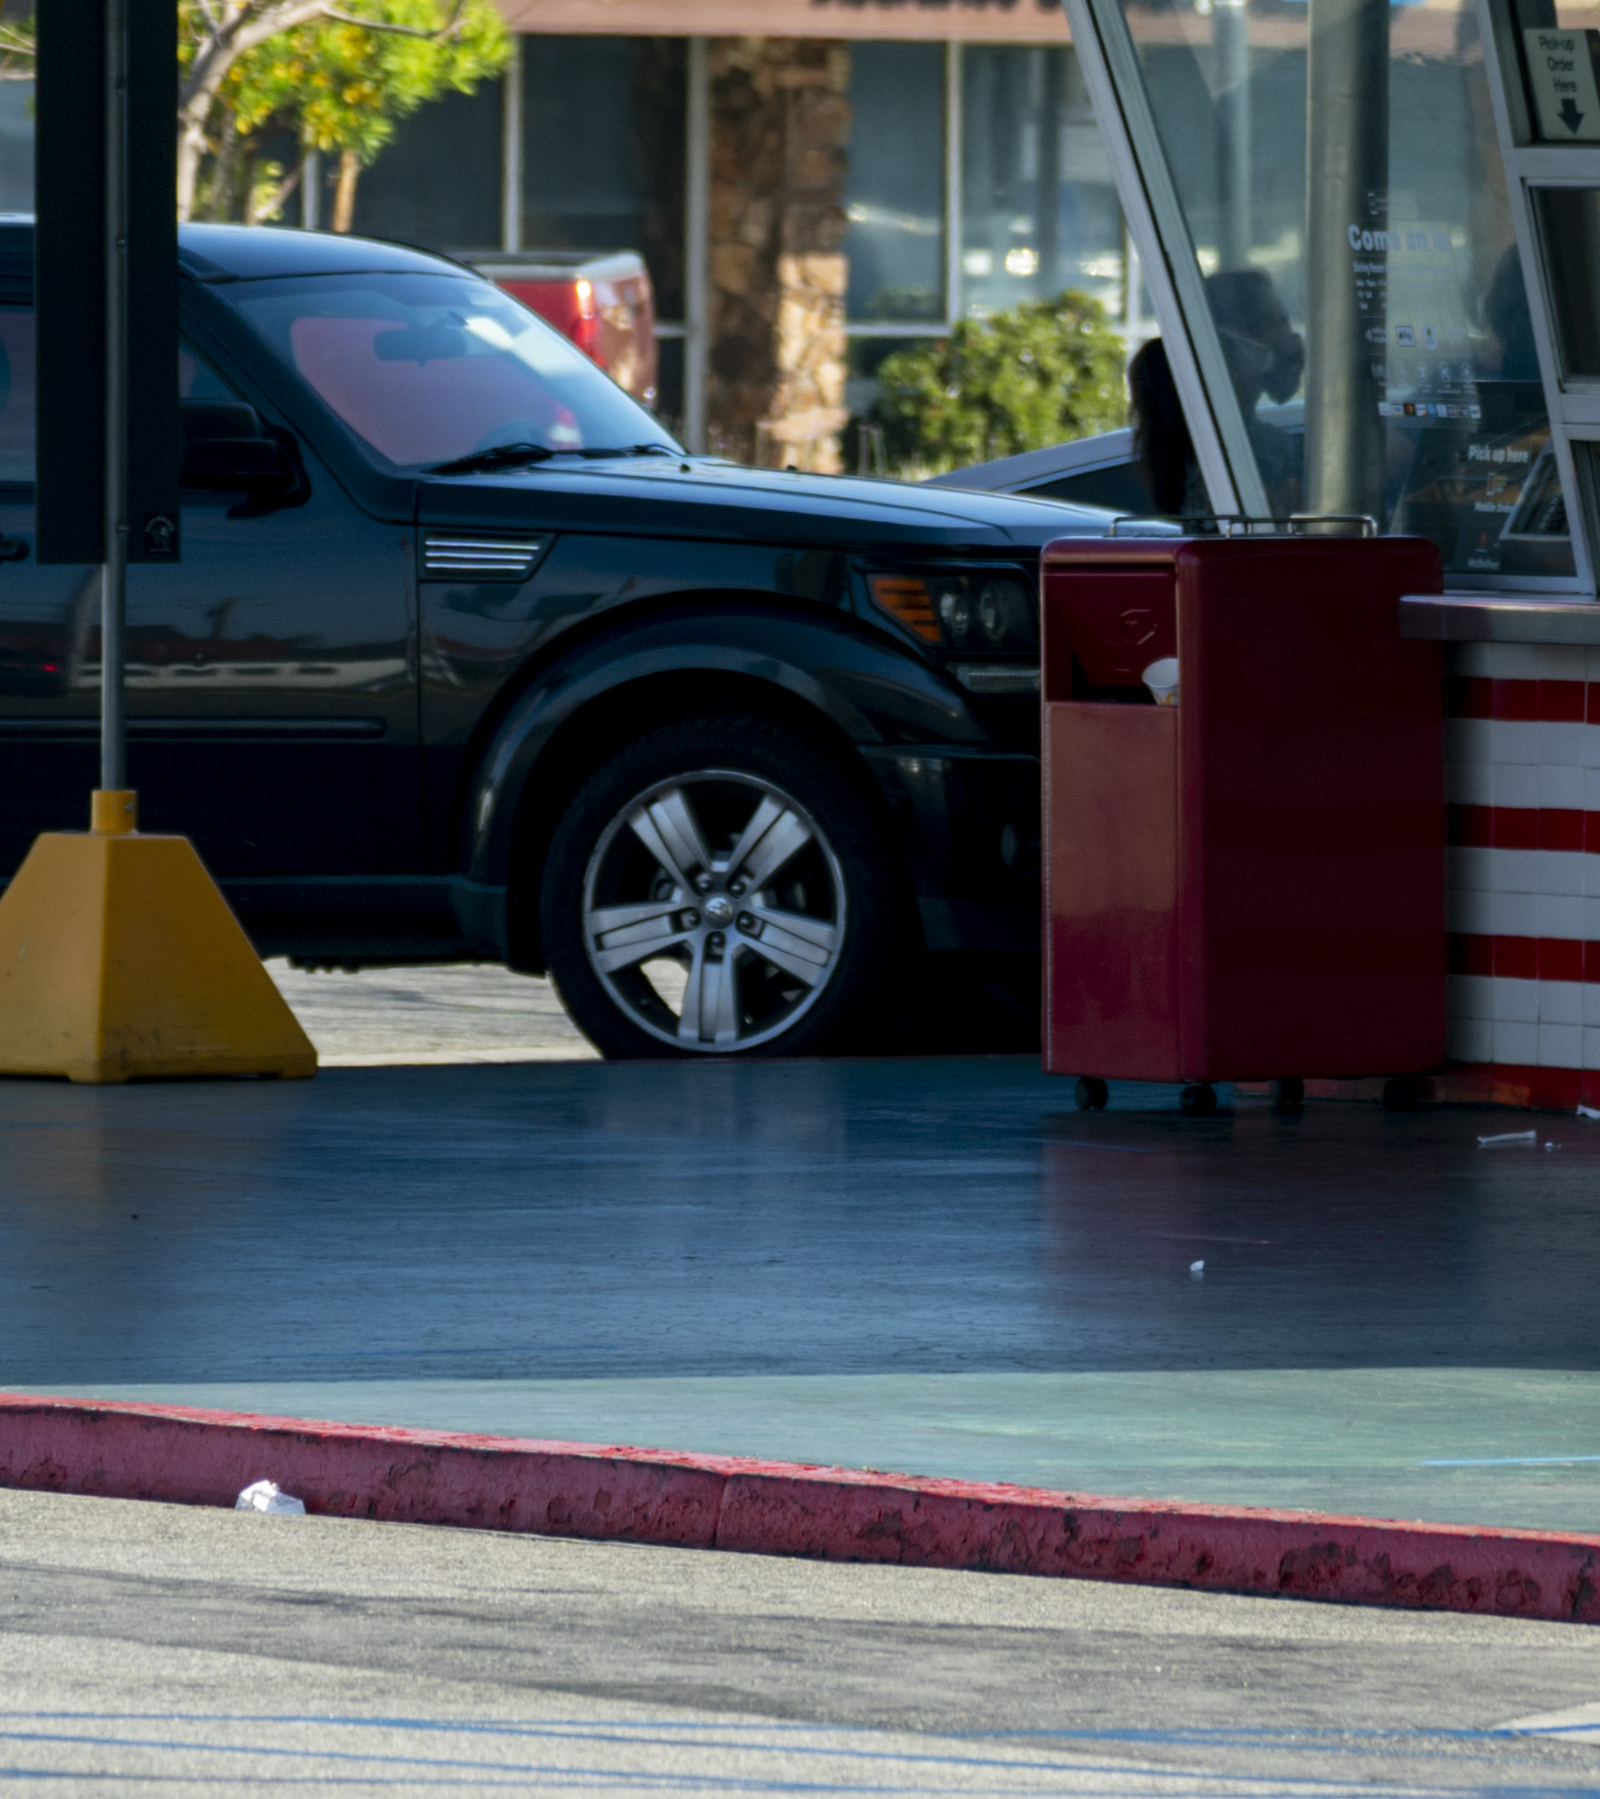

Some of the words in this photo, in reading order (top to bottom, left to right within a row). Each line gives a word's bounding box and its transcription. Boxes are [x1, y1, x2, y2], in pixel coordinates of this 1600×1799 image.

[1538, 35, 1575, 52] Pick-up
[1547, 57, 1574, 71] Order
[1553, 77, 1578, 92] Here
[1348, 223, 1401, 251] Come
[1468, 444, 1491, 461] Pick
[1492, 448, 1506, 465] up
[1506, 446, 1529, 463] here
